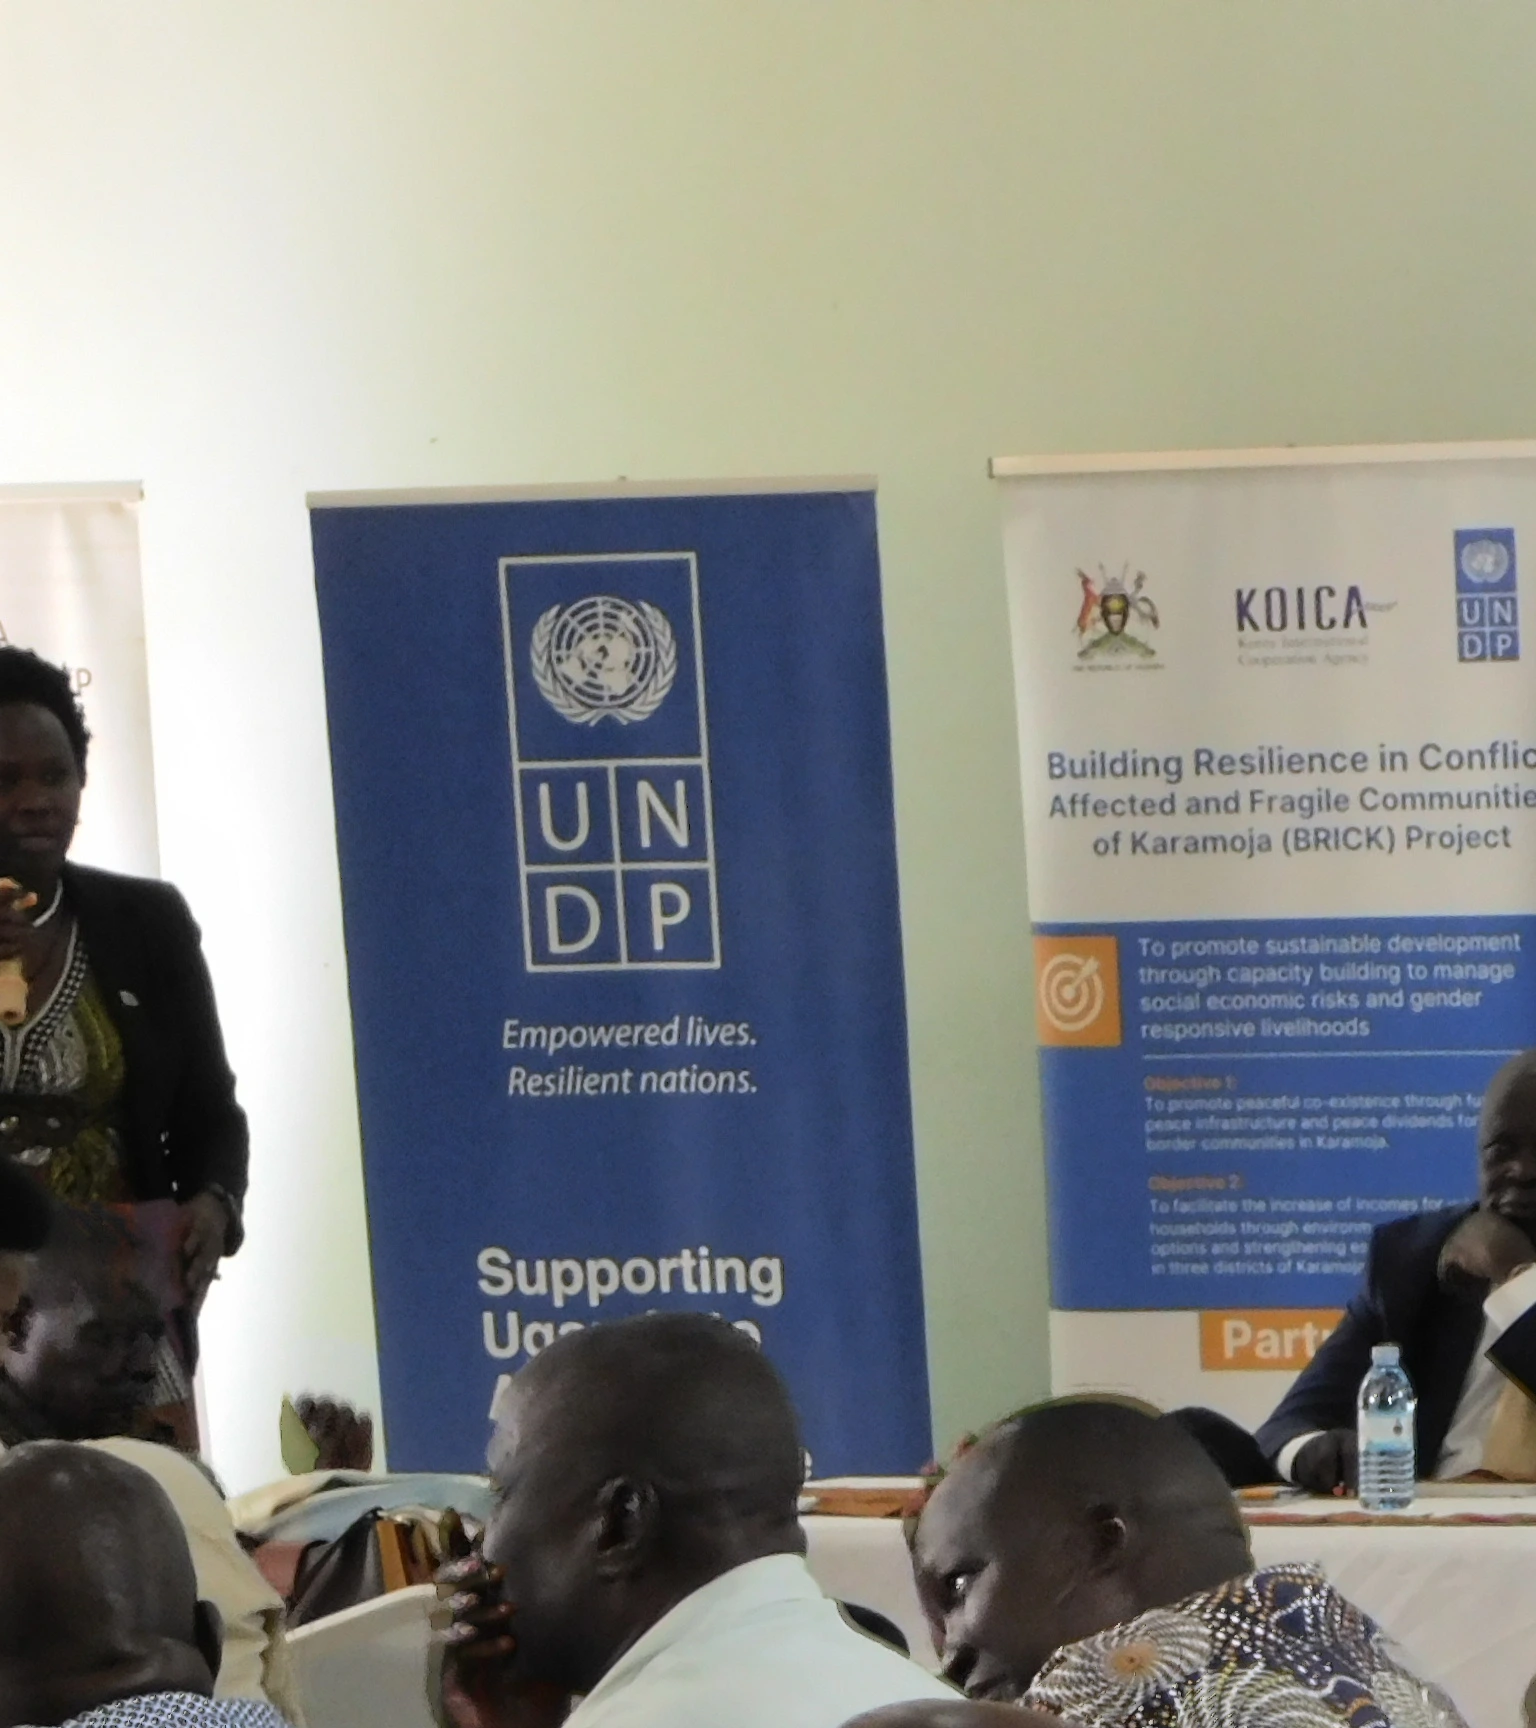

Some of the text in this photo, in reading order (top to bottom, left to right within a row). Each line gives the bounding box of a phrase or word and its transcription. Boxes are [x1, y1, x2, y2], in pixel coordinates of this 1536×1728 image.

[1234, 584, 1368, 632] KOICA
[1047, 748, 1183, 785] Building
[1194, 745, 1368, 777] Resilience
[1378, 743, 1409, 773] in
[1048, 791, 1177, 819] Affected
[1184, 789, 1241, 816] and
[1248, 787, 1351, 820] Fragile
[1092, 823, 1512, 859] of Karamoja (BRICK) Project
[1138, 933, 1522, 959] To promote sustainable development
[1139, 962, 1516, 988] through capacity building to manage
[1140, 988, 1483, 1013] social economic risks and gender
[501, 1015, 758, 1056] Empowered lives.
[1140, 1017, 1371, 1042] responsive livelihoods
[507, 1064, 758, 1098] Resilient nations.
[1167, 1097, 1233, 1113] promote
[1236, 1095, 1301, 1112] peaceful
[1404, 1094, 1463, 1111] through
[1144, 1119, 1192, 1133] peace
[1195, 1115, 1296, 1131] infrastructure
[1300, 1115, 1329, 1130] and
[1332, 1116, 1379, 1132] peace
[1381, 1114, 1455, 1129] dividends
[1145, 1136, 1197, 1151] border
[1200, 1135, 1296, 1151] communities
[1298, 1135, 1313, 1150] in
[1150, 1198, 1170, 1213] To
[1173, 1198, 1238, 1213] facilitate
[1241, 1198, 1267, 1212] the
[1270, 1198, 1333, 1213] increase
[1336, 1197, 1352, 1212] of
[1148, 1221, 1372, 1237] households through environm
[1150, 1242, 1207, 1257] options
[1211, 1241, 1240, 1255] and
[1243, 1240, 1347, 1257] strengthening
[476, 1246, 785, 1307] Supporting
[1168, 1261, 1210, 1275] three
[1214, 1260, 1274, 1275] districts
[1276, 1259, 1292, 1275] of
[1296, 1259, 1366, 1275] Karamoj
[1222, 1318, 1334, 1360] Part
